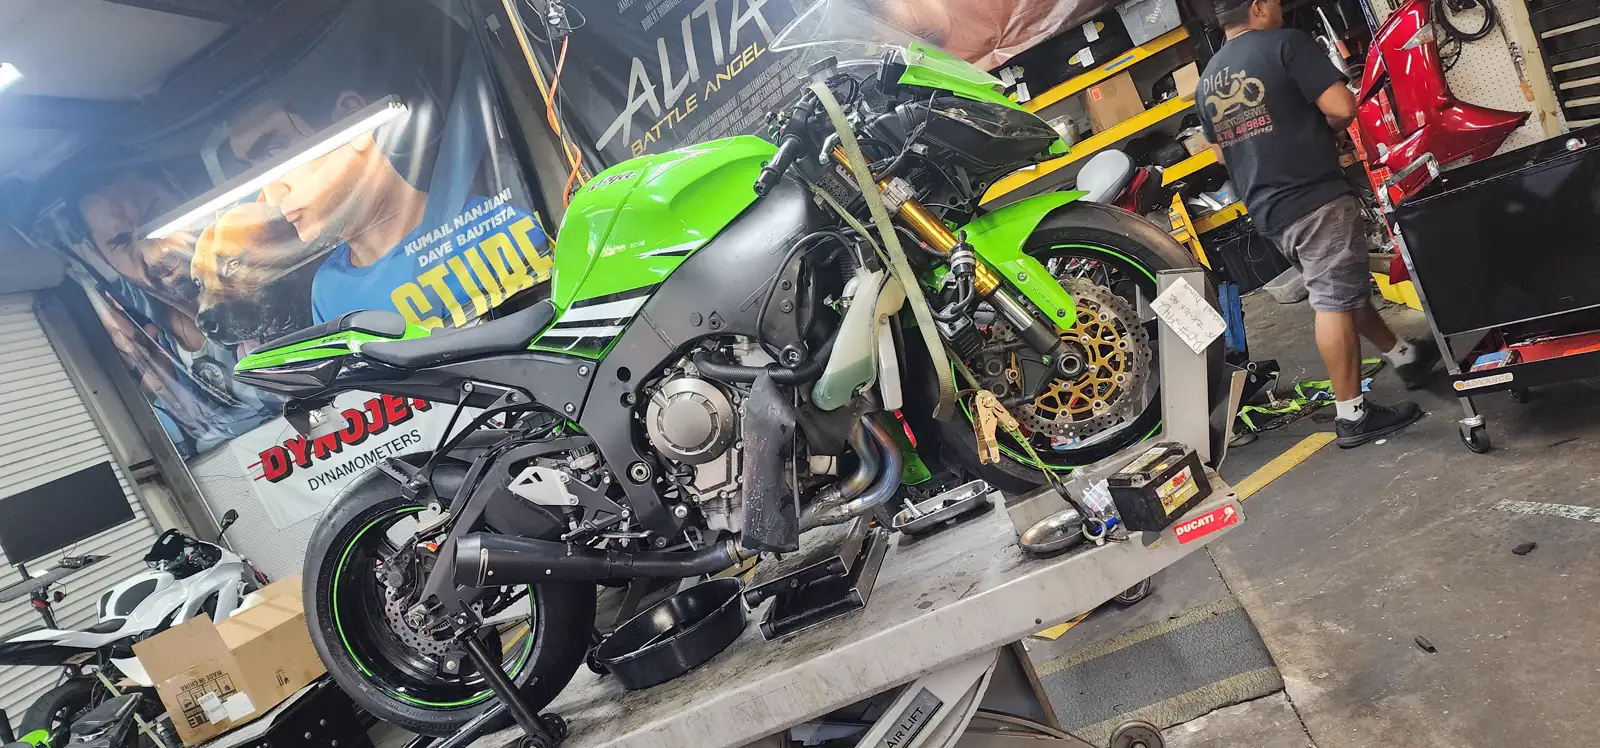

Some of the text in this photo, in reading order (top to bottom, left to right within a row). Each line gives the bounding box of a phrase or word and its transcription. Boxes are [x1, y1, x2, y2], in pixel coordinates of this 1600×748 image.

[630, 93, 699, 157] BATTLE
[703, 41, 767, 101] ANGEL
[1203, 66, 1230, 95] DIAZ
[403, 187, 512, 257] KUMAIL NANJIANI
[418, 206, 517, 267] DAVE BAUTISTA
[1464, 373, 1513, 388] ADVANCE
[307, 429, 422, 491] DYNAMOMETERS
[1175, 513, 1215, 536] DUCATI
[180, 680, 199, 692] CHINA
[886, 706, 923, 748] AIR LIFT
